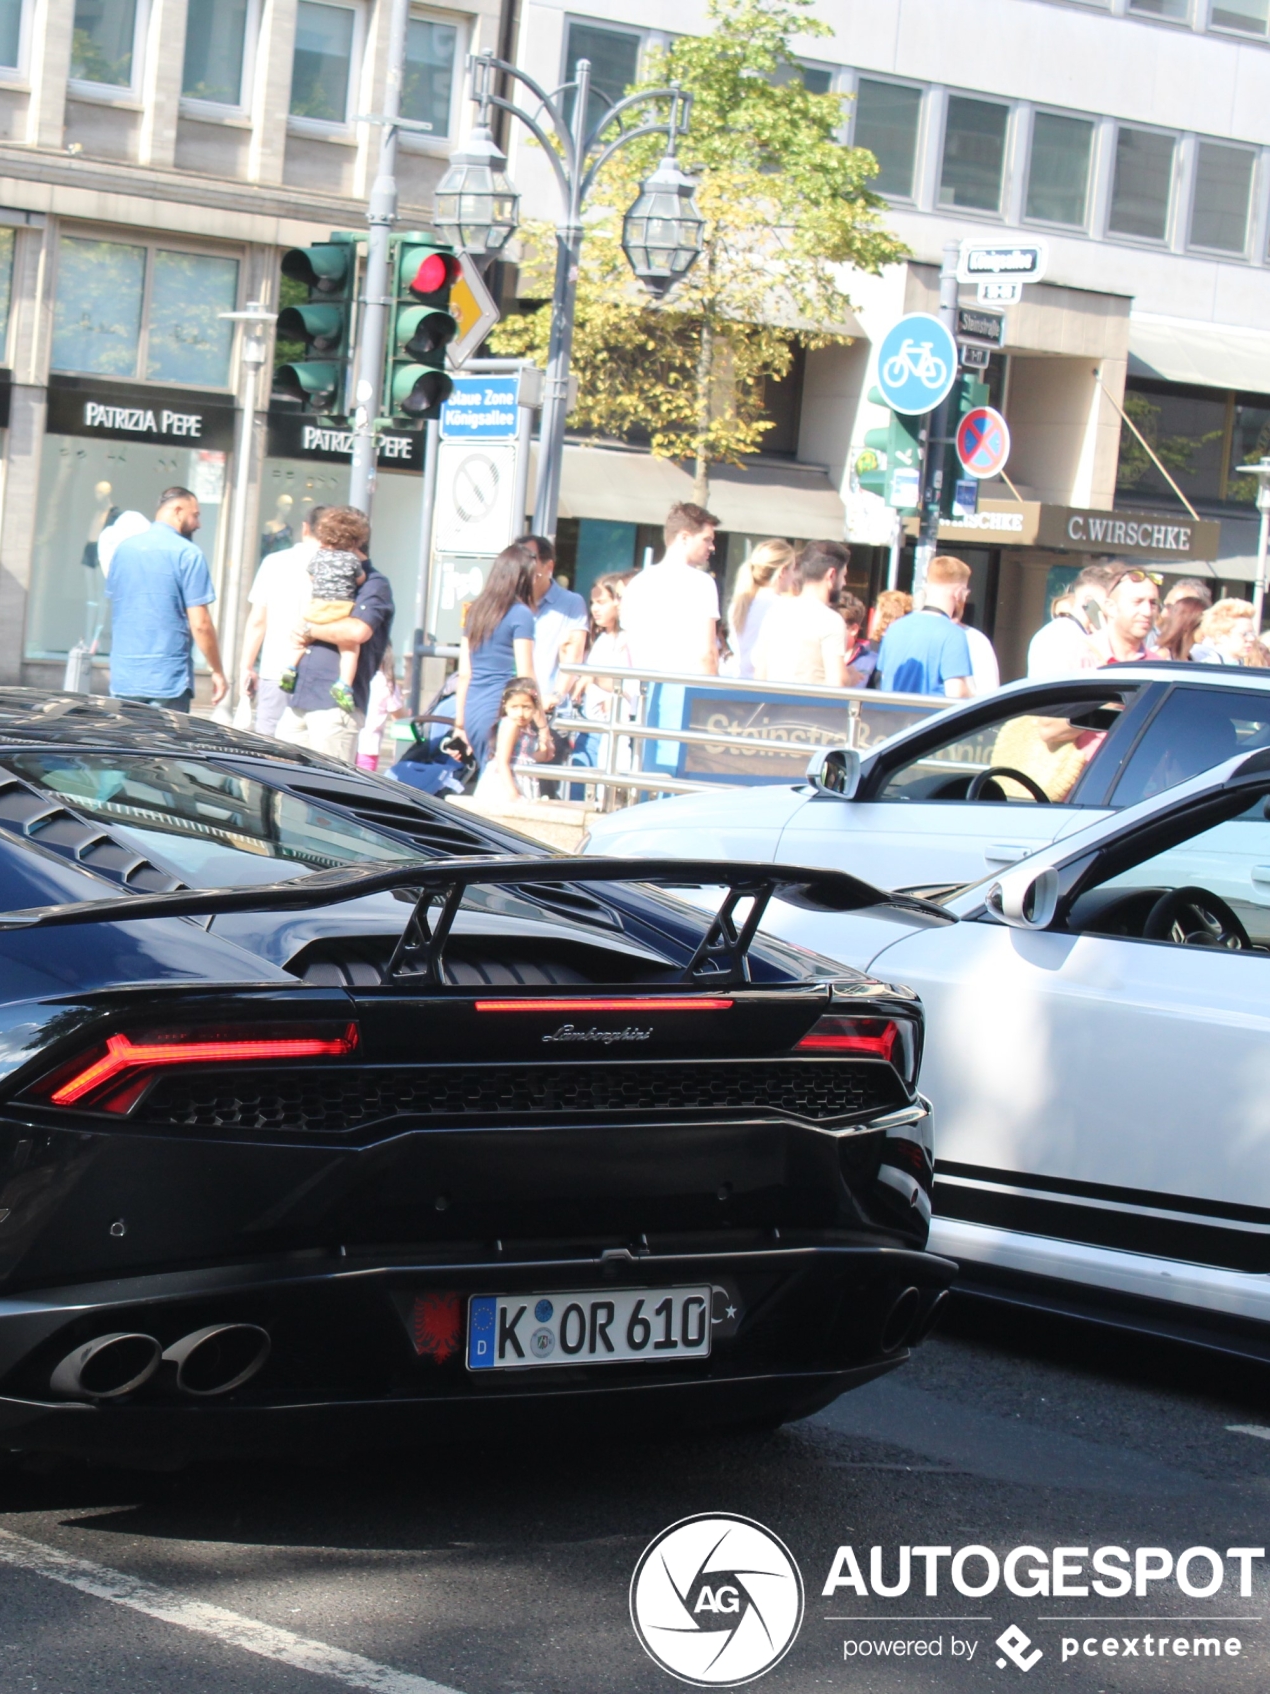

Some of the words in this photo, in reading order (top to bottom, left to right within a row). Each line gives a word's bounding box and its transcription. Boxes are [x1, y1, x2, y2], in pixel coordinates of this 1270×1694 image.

[484, 389, 514, 406] Zone
[84, 402, 157, 433] PATRIZIA
[161, 409, 202, 437] PEPE
[445, 410, 514, 429] Königsallee
[542, 1024, 653, 1044] Lamborghini
[498, 1304, 527, 1359] K
[559, 1300, 615, 1355] OR
[626, 1295, 707, 1351] 610
[477, 1340, 487, 1355] D
